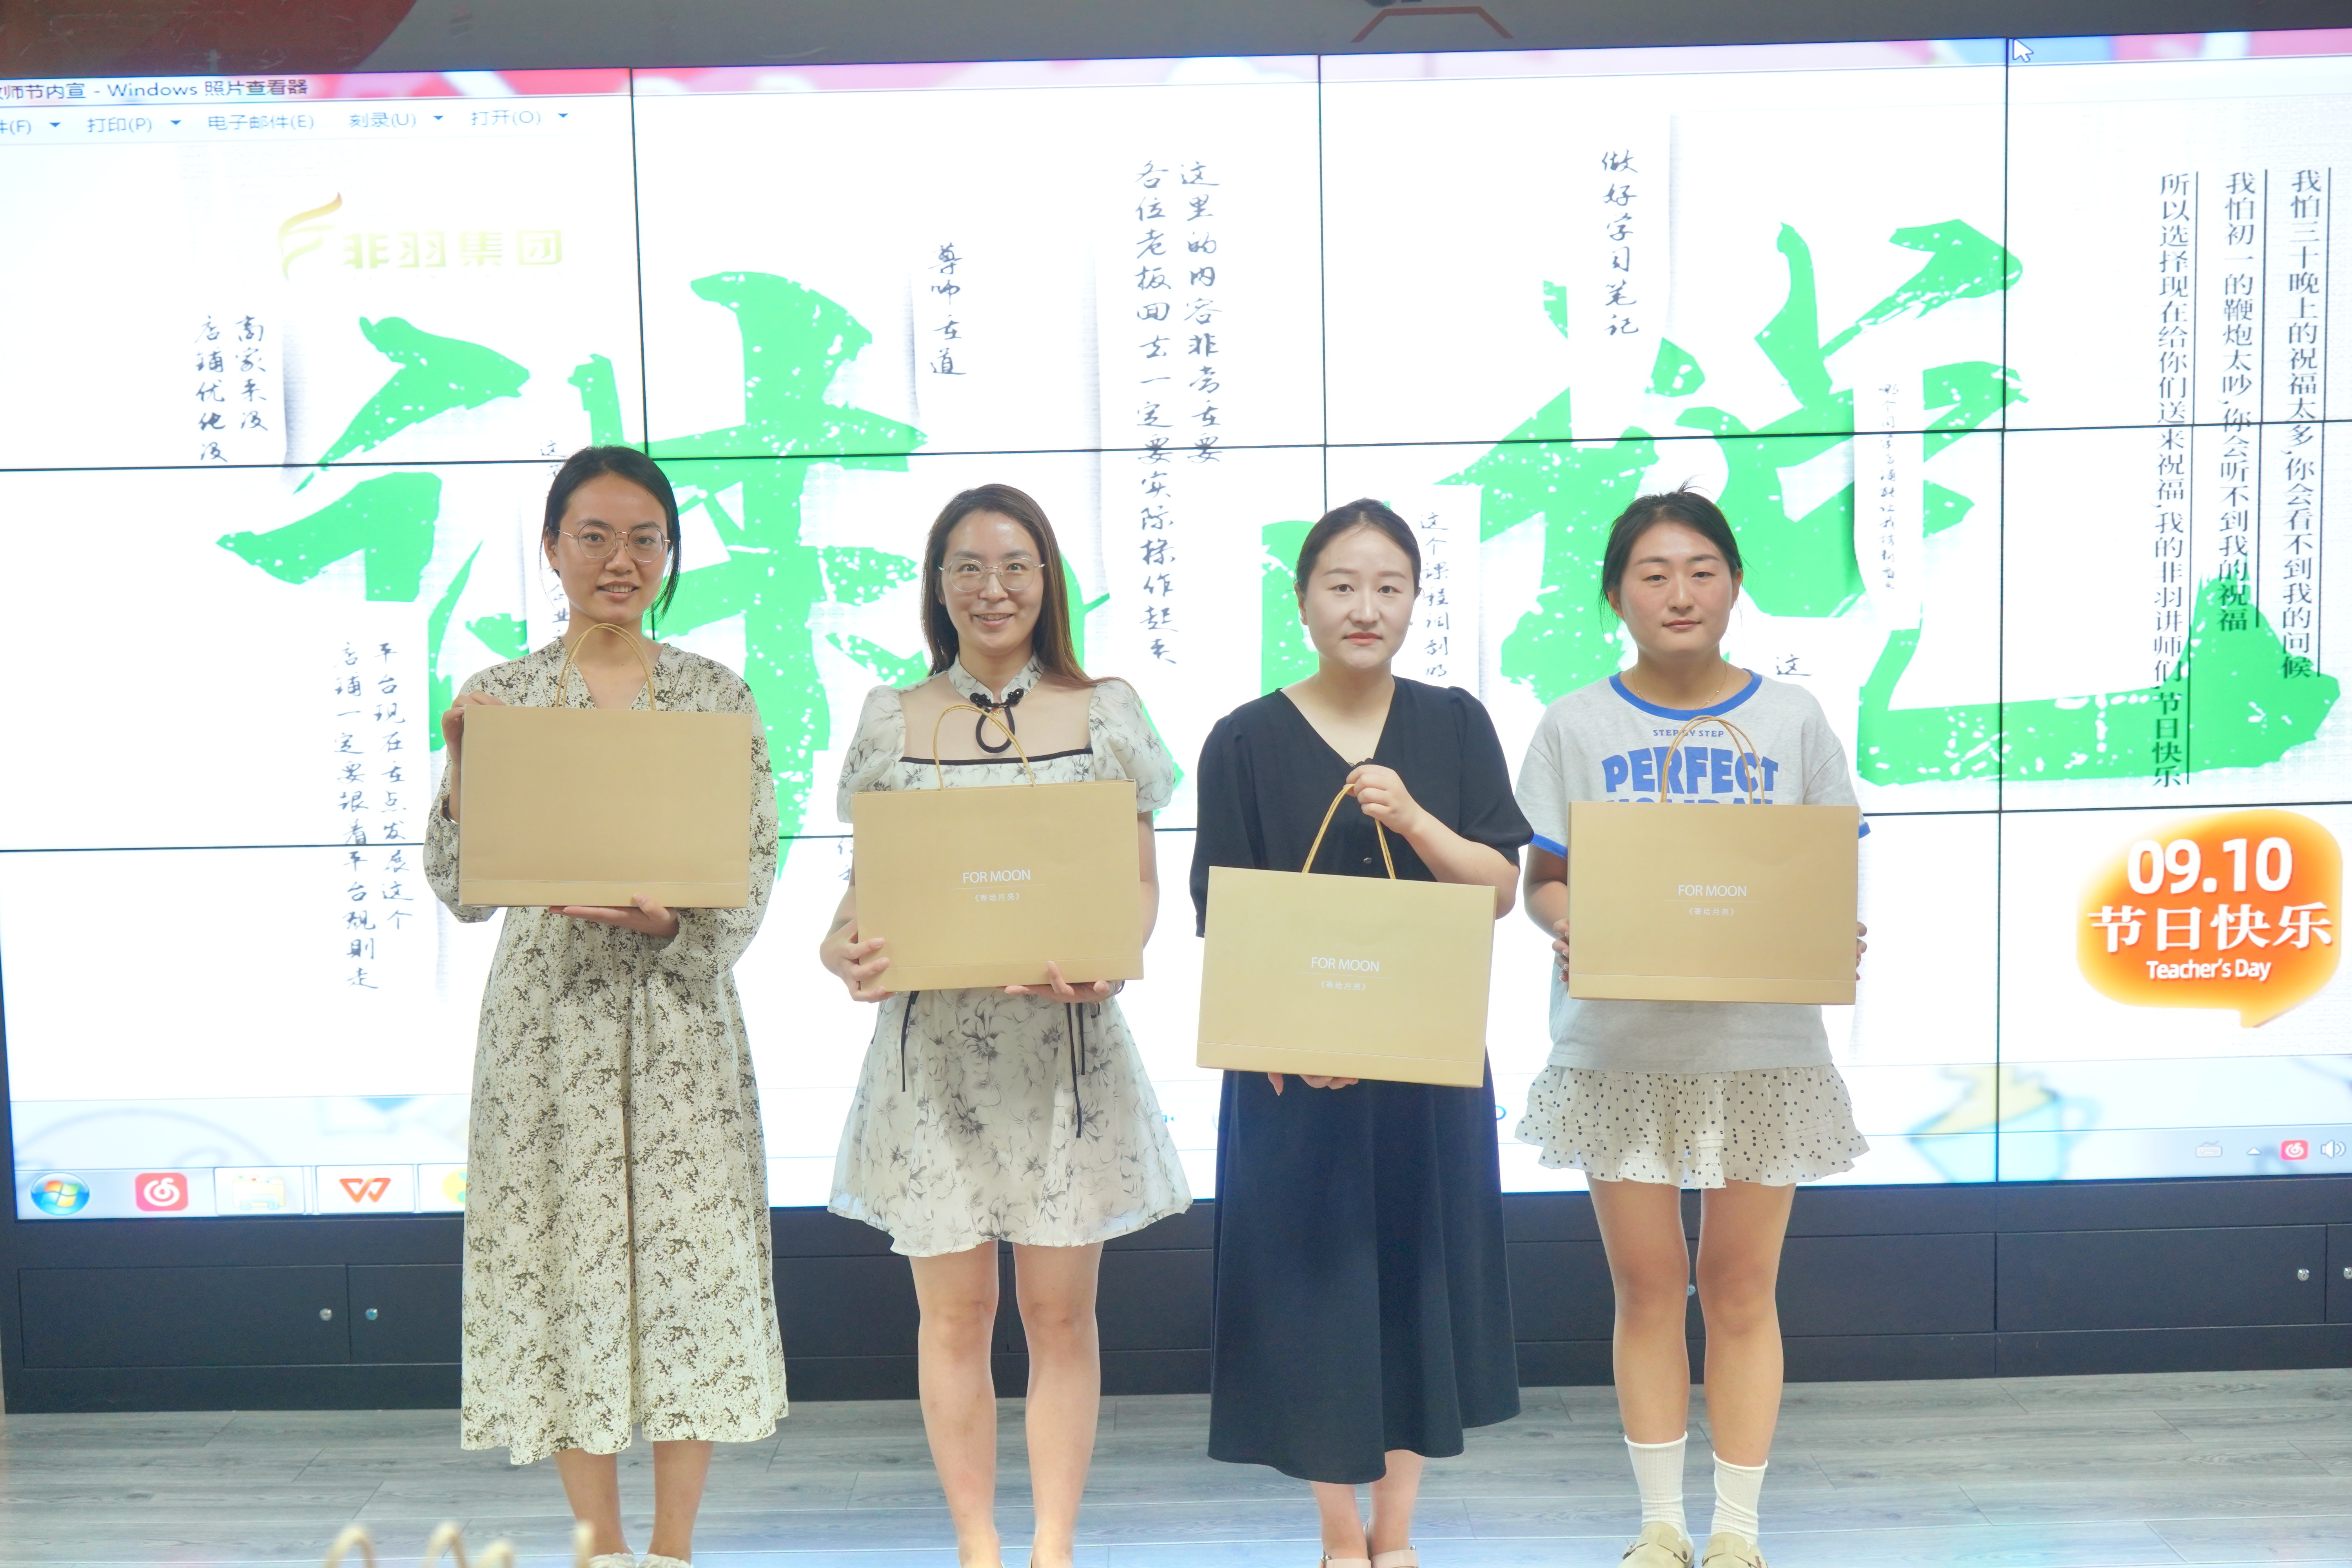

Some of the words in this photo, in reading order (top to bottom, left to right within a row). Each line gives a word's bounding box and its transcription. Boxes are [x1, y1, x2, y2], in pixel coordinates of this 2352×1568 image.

[107, 82, 198, 96] Windows
[205, 79, 307, 96] 照片查看器
[87, 117, 152, 132] 打印(P)
[208, 115, 314, 130] 电子邮件(E)
[350, 112, 416, 128] 刻录(U)
[472, 110, 541, 125] 打开(O)
[343, 230, 562, 269] 非羽集团
[1601, 746, 1779, 795] PERFECT
[2127, 837, 2293, 895] 09.10
[962, 871, 987, 883] FOR
[990, 869, 1031, 882] MOON
[1678, 884, 1703, 896] FOR
[1705, 885, 1747, 897] MOON
[2087, 901, 2333, 953] 节日快乐
[1310, 956, 1336, 969] FOR
[1338, 958, 1380, 972] MOON
[2146, 958, 2231, 979] Teacher's
[2234, 959, 2272, 981] Day
